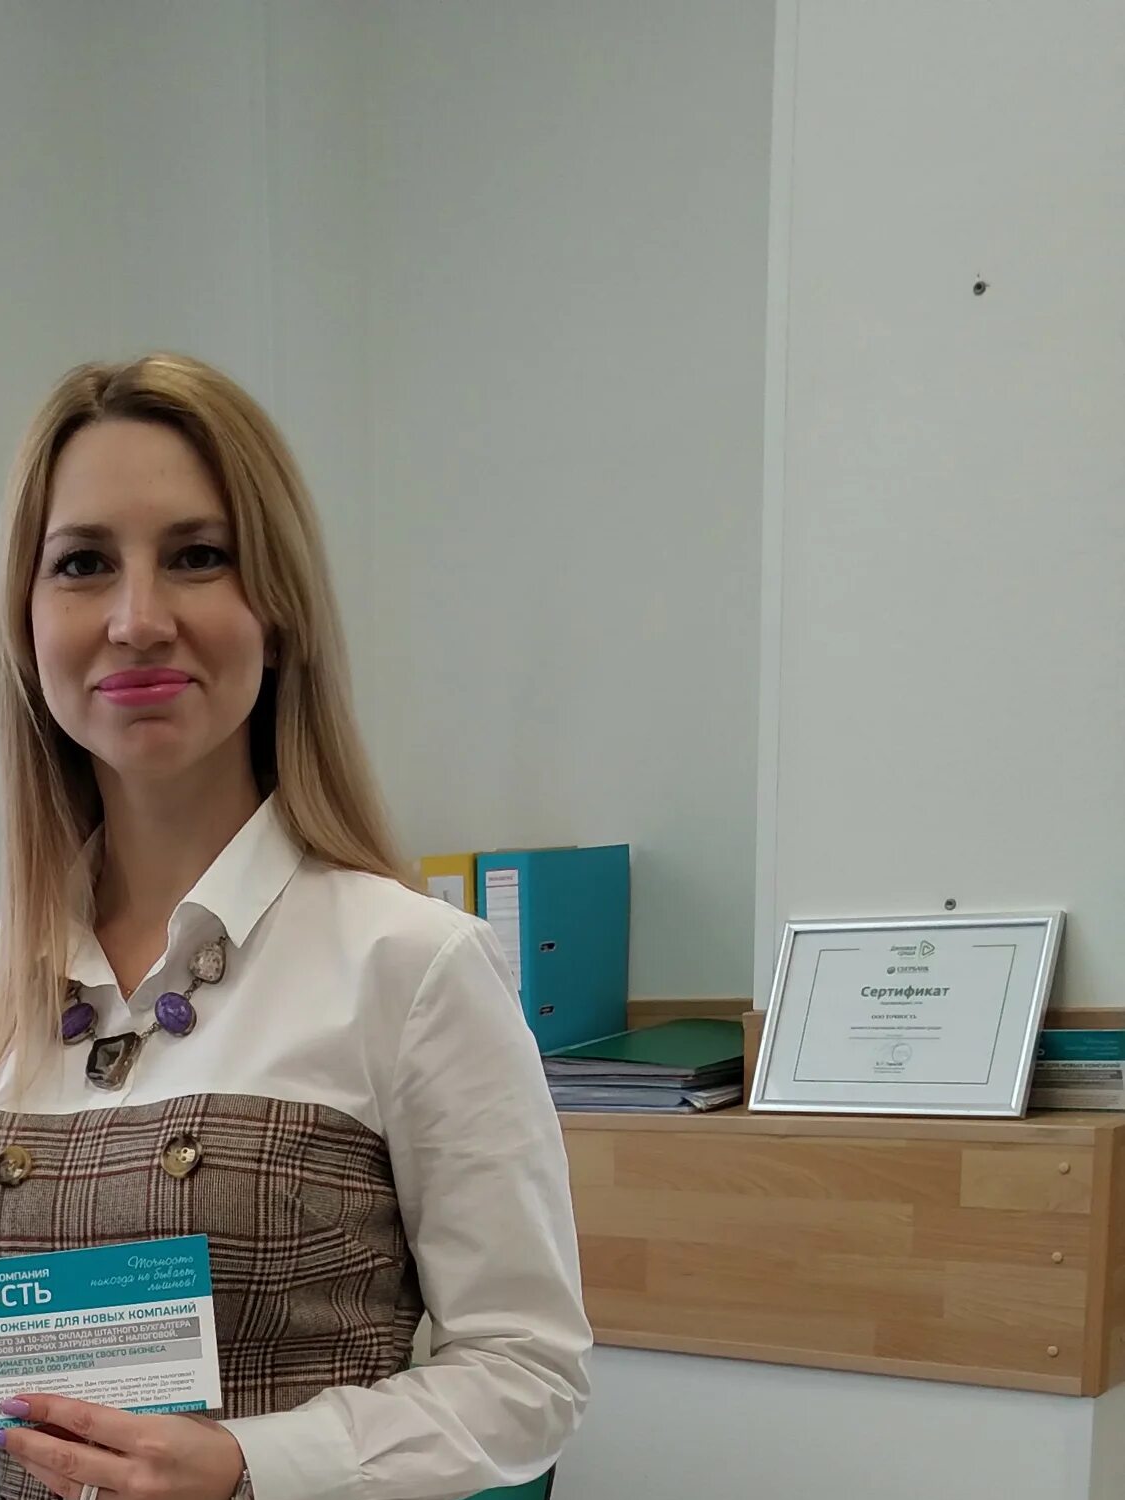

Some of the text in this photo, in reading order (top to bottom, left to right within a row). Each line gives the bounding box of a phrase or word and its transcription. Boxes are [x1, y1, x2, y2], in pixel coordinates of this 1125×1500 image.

[860, 985, 950, 1000] Сертификат
[54, 1316, 80, 1330] ДЛЯ
[82, 1311, 125, 1325] НОВЫХ
[128, 1301, 197, 1320] КОМПАНИЙ
[14, 1336, 25, 1344] ЗА
[28, 1333, 56, 1342] 10-20%
[58, 1330, 91, 1340] ОКЛАДА
[94, 1325, 137, 1336] ШТАТНОГО
[139, 1320, 190, 1331] БУХГАЛТЕРА
[23, 1342, 55, 1352] ПРОЧИХ
[58, 1335, 116, 1348] ЗАТРУДНЕНИЙ
[125, 1328, 177, 1342] НАЛОГОВОЙ.
[45, 1352, 93, 1363] РАЗВИТИЕМ
[95, 1348, 126, 1358] СВОЕГО
[129, 1345, 166, 1354] БИЗНЕСА
[21, 1366, 33, 1375] ДО
[63, 1360, 94, 1370] РУБЛЕЙ
